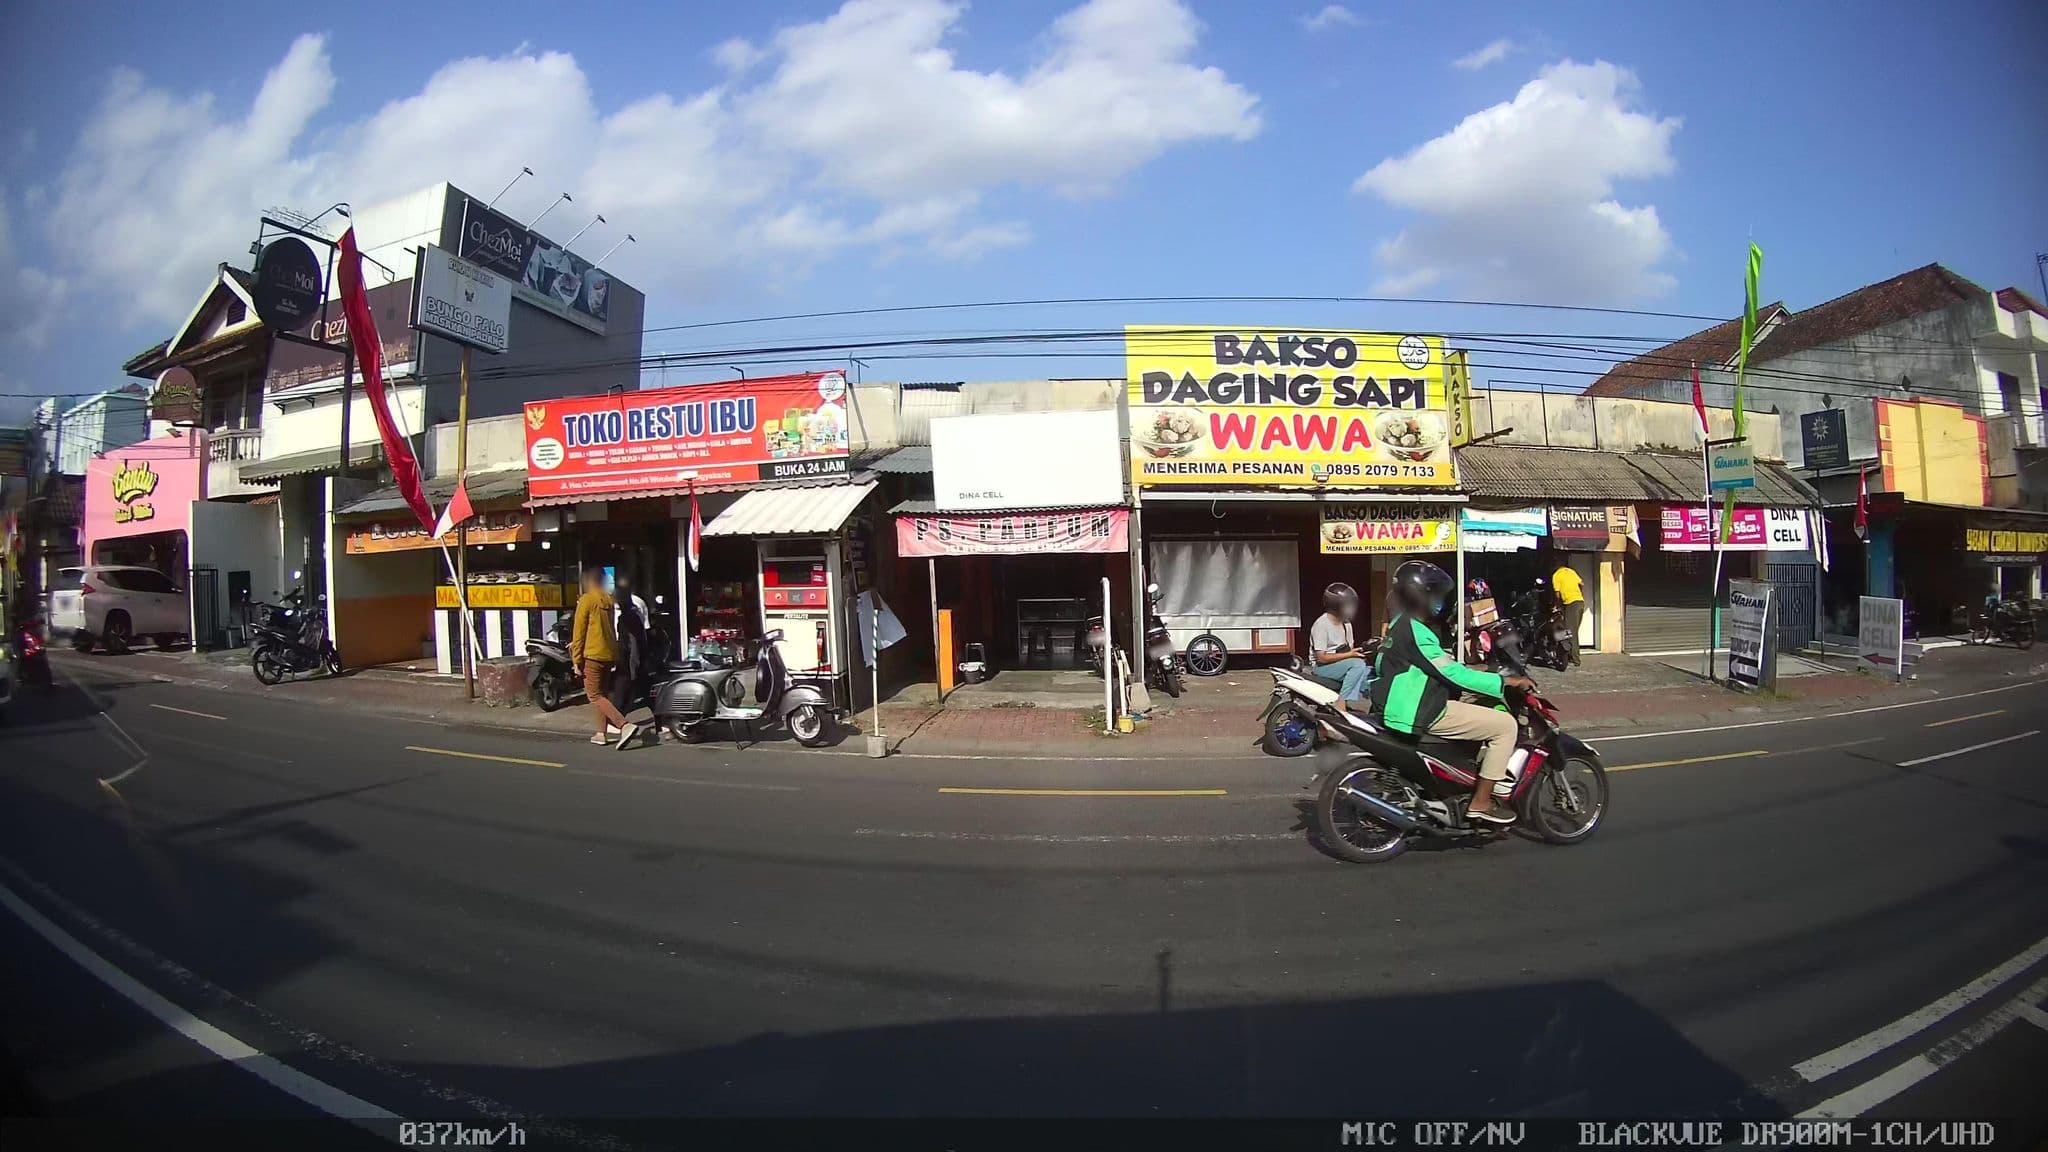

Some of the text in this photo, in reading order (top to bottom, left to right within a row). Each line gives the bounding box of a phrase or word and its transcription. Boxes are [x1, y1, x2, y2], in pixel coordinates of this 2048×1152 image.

[426, 296, 504, 338] BUNGO PALO
[1214, 334, 1357, 368] BAKSO
[1142, 371, 1426, 409] DAGING SAPI
[1449, 362, 1463, 437] BAKSO
[564, 396, 757, 447] TOKO RESTU IBU
[1209, 412, 1372, 452] WAWA
[775, 461, 846, 477] BUKA 24 JAM
[1143, 462, 1435, 478] MENERIMA PESANAN 0895 2079 7133
[959, 491, 1004, 500] DINA CELL
[1325, 504, 1450, 520] BAKSO DAGING SAPI
[1551, 510, 1605, 523] SIGNATURE
[1771, 508, 1800, 521] DINA
[979, 515, 1110, 540] PARFUM
[1355, 521, 1424, 540] WAWA
[1774, 529, 1801, 542] CELL
[1862, 602, 1897, 624] DINA
[1861, 627, 1895, 649] CELL
